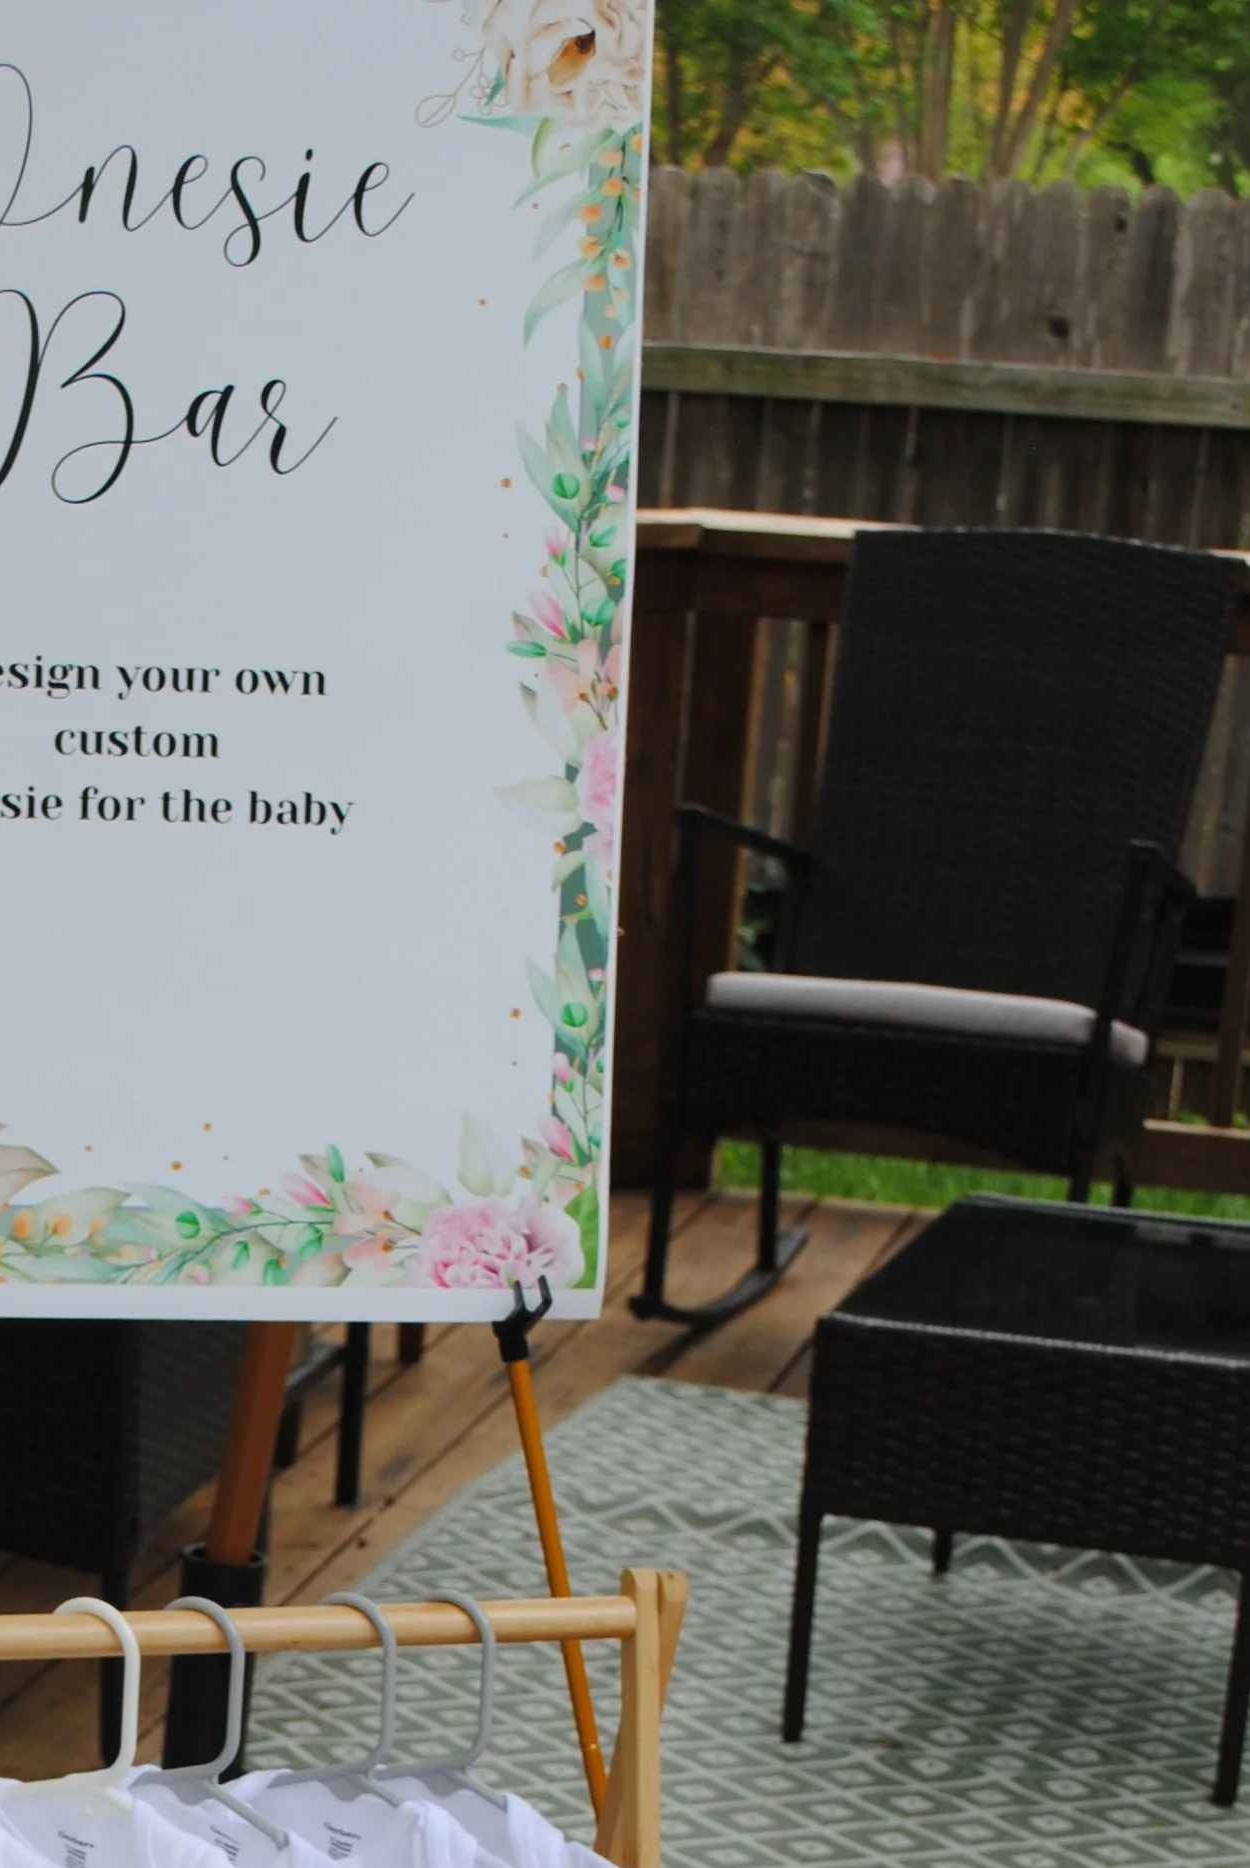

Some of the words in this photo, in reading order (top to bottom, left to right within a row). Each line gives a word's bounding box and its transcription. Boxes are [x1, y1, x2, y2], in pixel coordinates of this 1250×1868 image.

[115, 665, 221, 700] your
[234, 668, 326, 696] own
[53, 725, 219, 759] custom
[79, 785, 146, 822] for
[160, 788, 233, 825] the
[249, 790, 354, 836] baby
